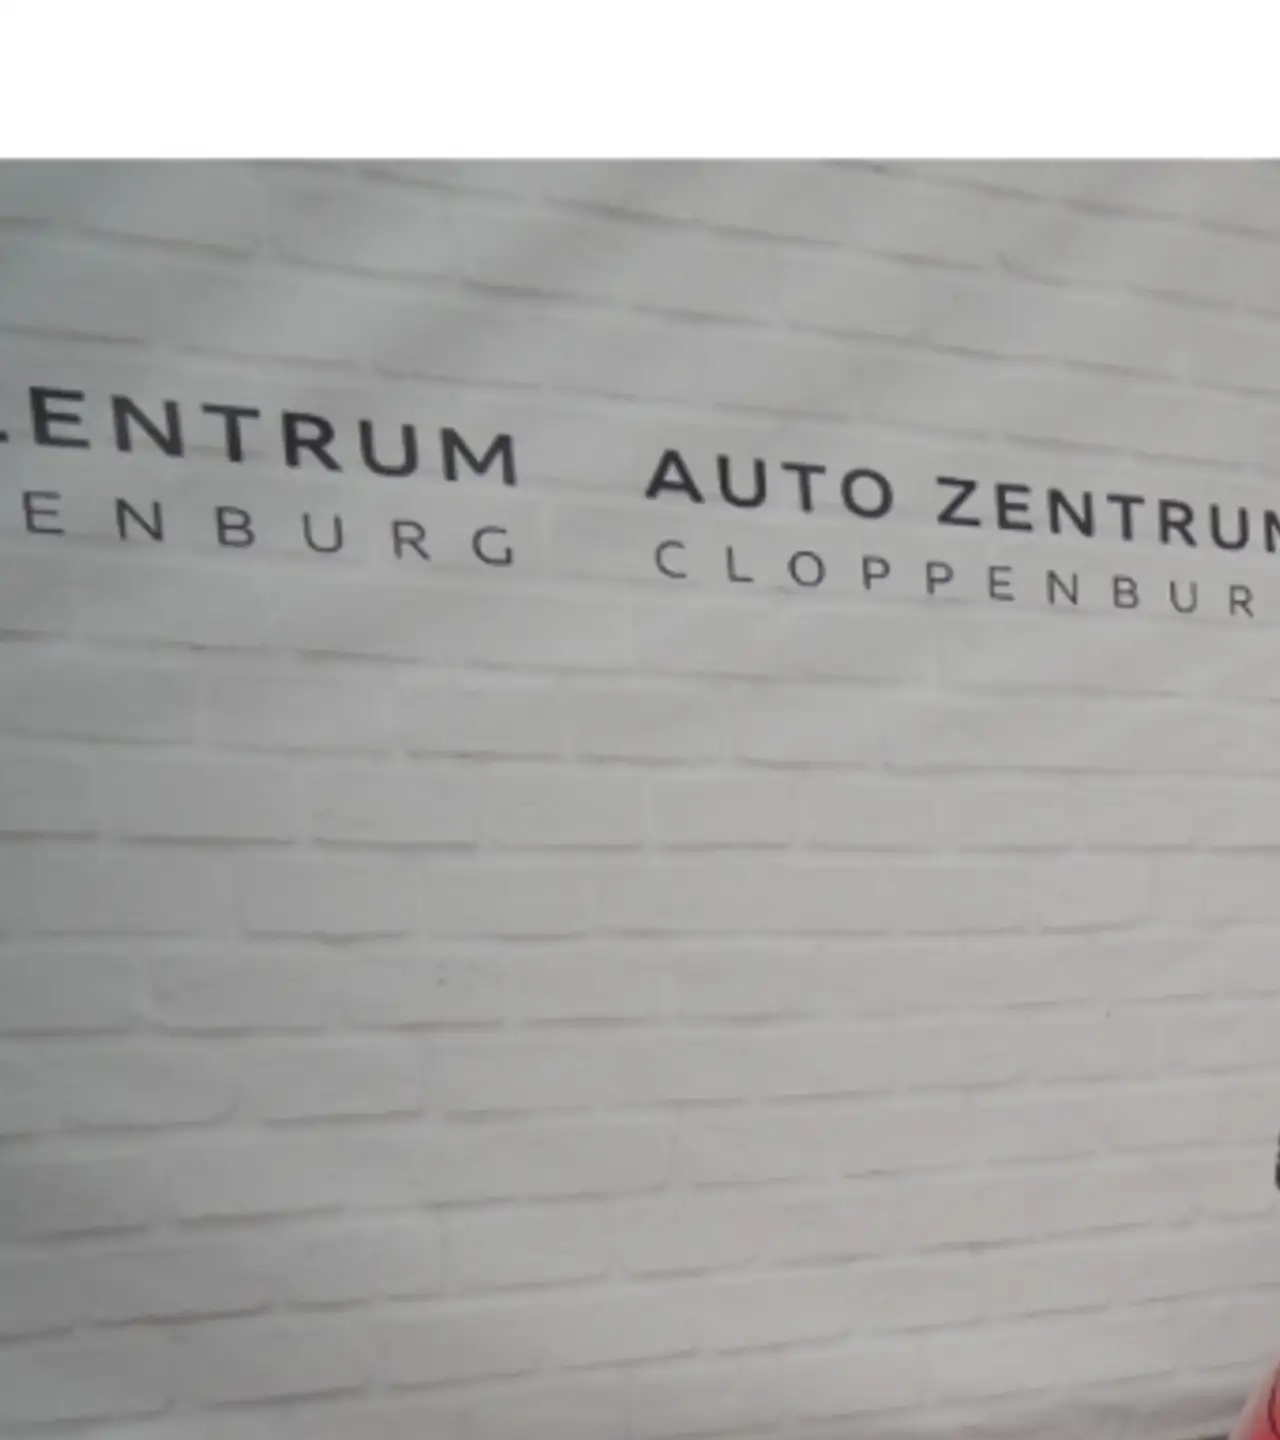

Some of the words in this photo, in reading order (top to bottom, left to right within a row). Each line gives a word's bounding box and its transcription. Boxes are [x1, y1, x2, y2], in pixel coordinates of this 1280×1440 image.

[0, 384, 519, 488] ENTRUM
[643, 447, 895, 522] AUTO
[20, 490, 516, 568] ENBURG
